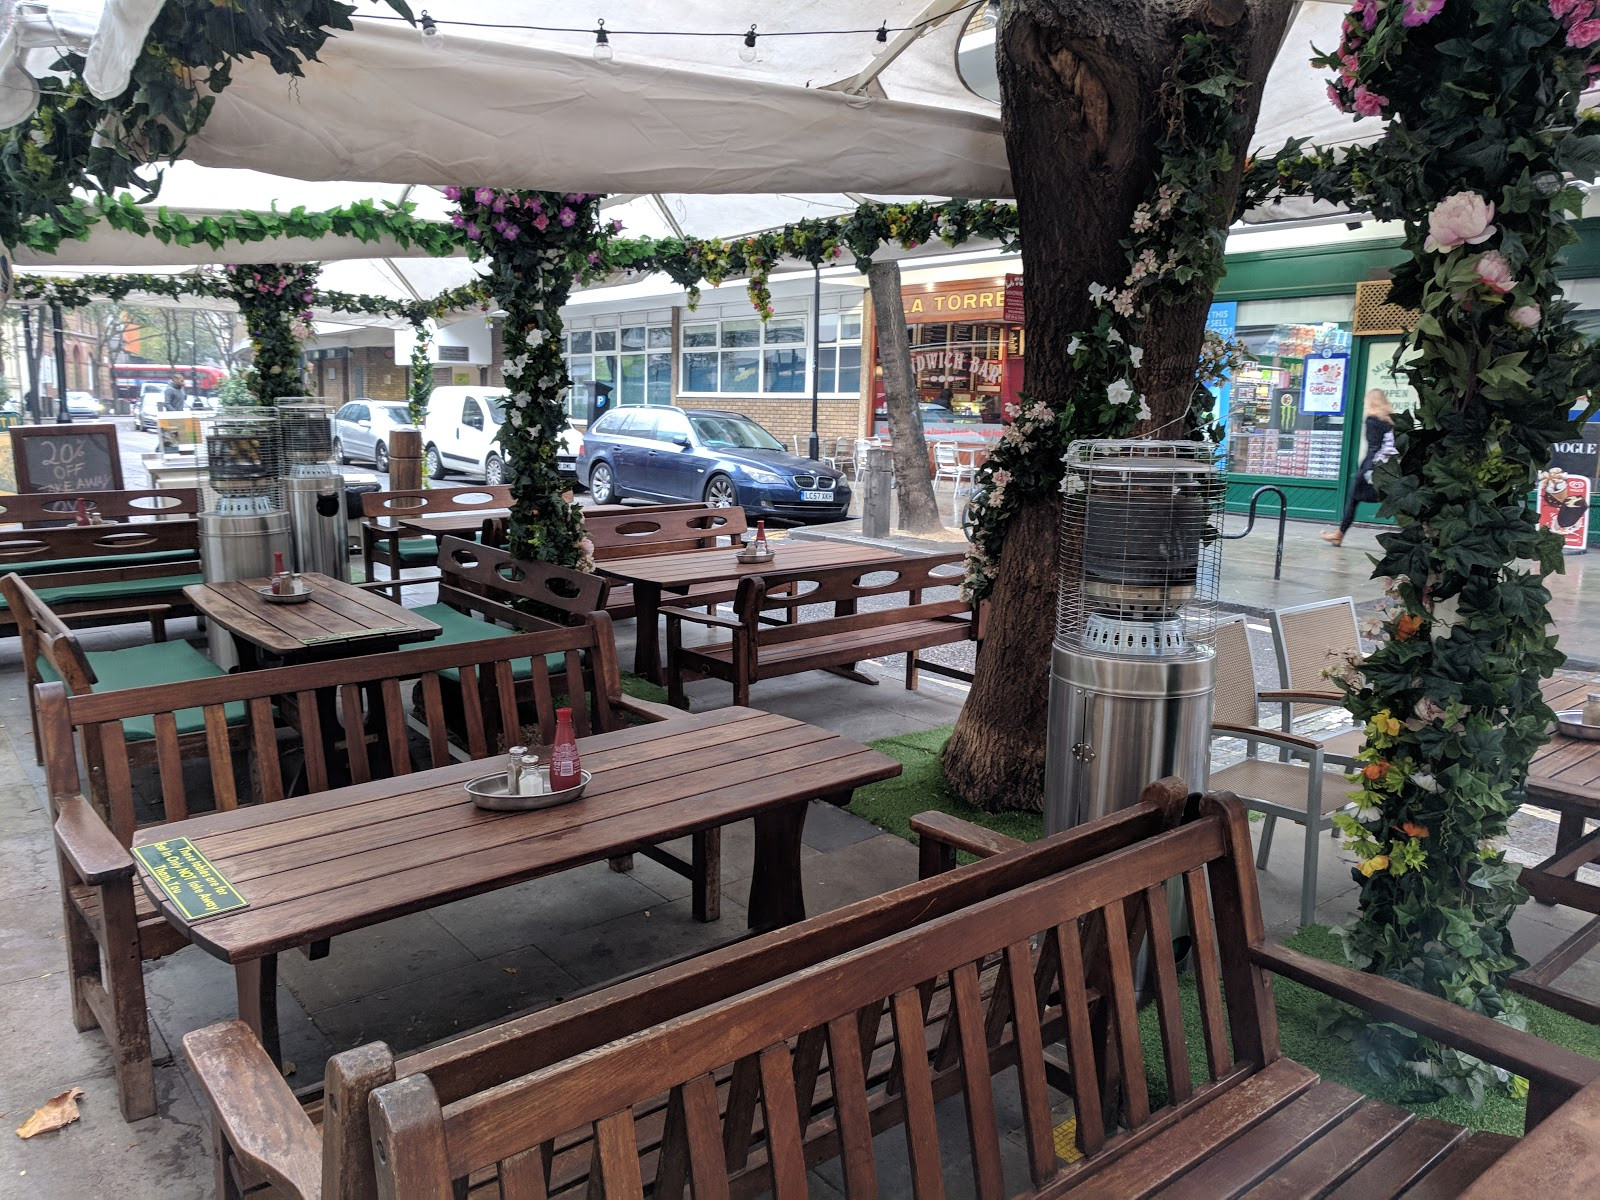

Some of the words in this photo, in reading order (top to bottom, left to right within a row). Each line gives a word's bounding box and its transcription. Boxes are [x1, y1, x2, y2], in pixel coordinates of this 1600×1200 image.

[934, 291, 1005, 311] TORRE
[1210, 319, 1228, 327] SELL
[1211, 310, 1229, 319] THIS
[969, 356, 1001, 384] BAR
[1553, 442, 1597, 455] VOGUE
[53, 462, 85, 479] OFF
[153, 864, 176, 883] Thank
[168, 881, 182, 894] You
[178, 846, 197, 862] These
[191, 860, 211, 879] tables
[205, 876, 220, 888] are
[214, 885, 229, 896] for
[166, 856, 184, 869] Only
[176, 867, 197, 881] NOT
[197, 893, 221, 911] Away
